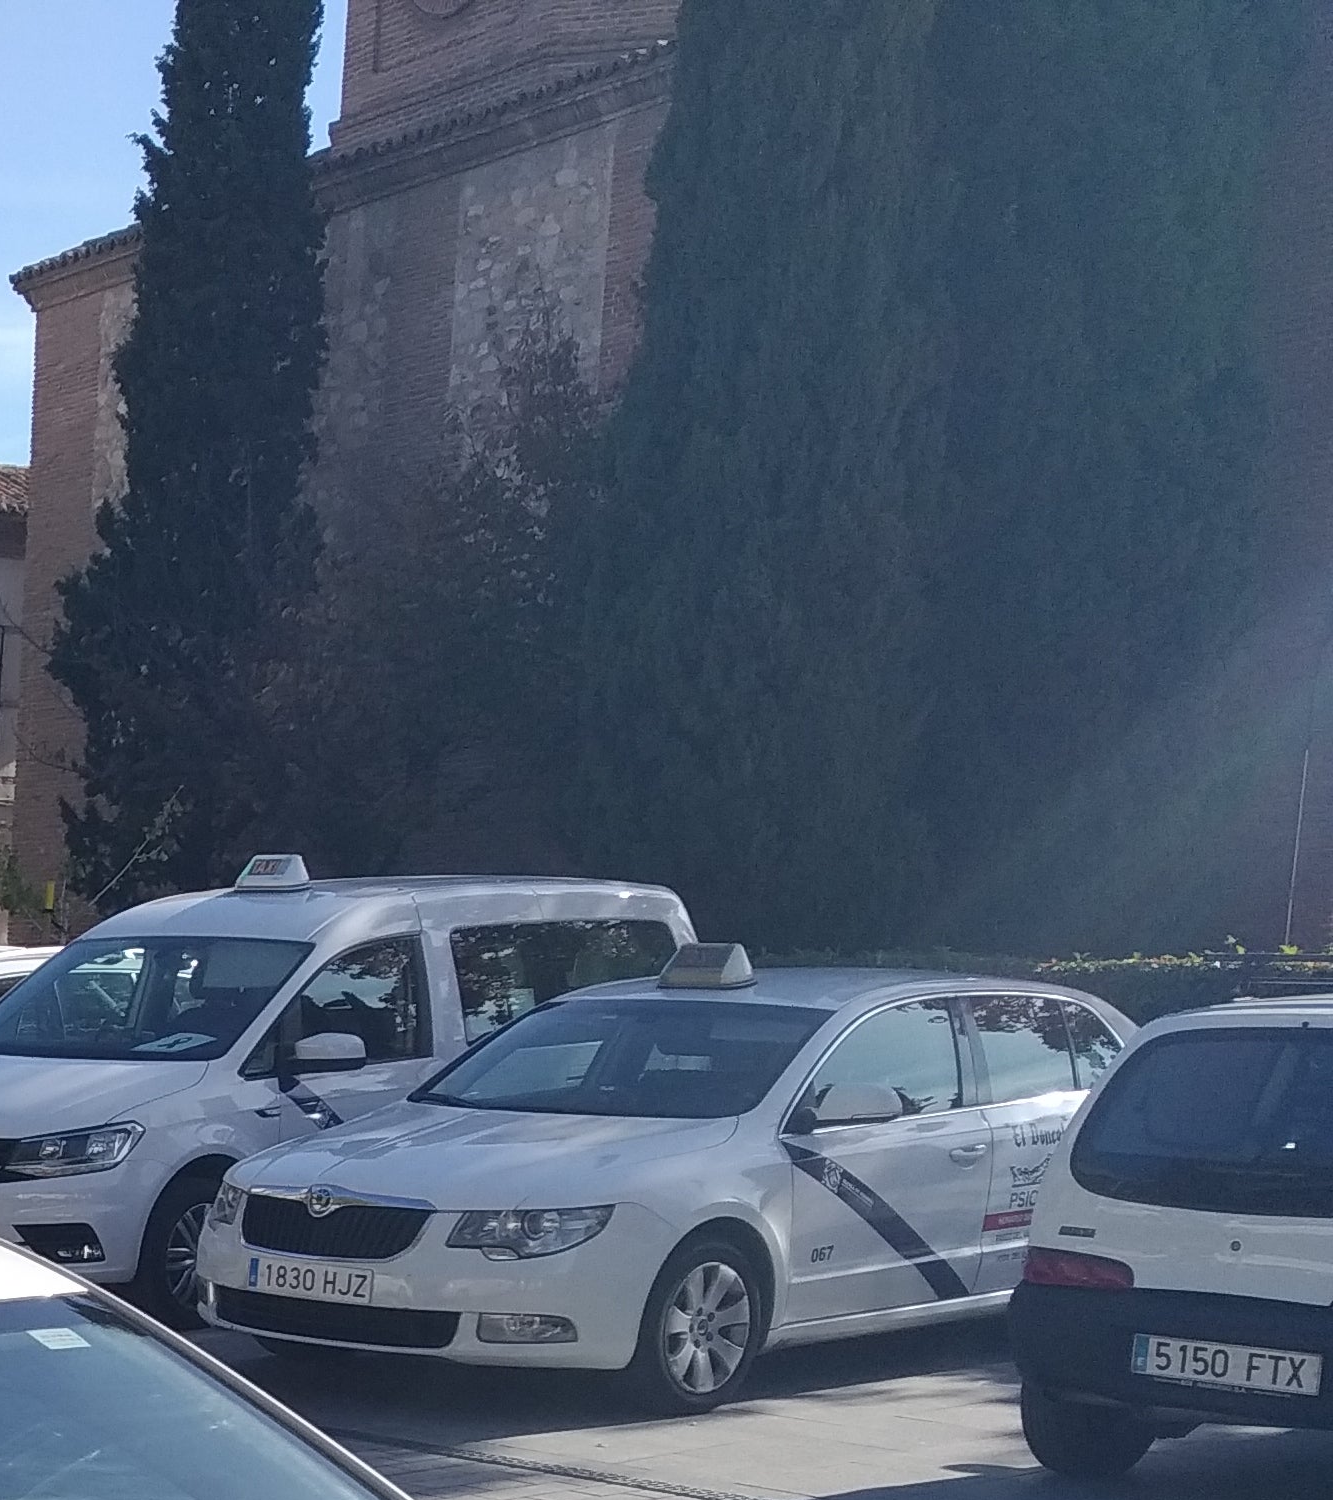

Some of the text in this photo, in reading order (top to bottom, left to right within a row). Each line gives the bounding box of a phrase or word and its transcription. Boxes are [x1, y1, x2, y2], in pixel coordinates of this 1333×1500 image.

[252, 861, 280, 874] TAXI
[811, 1244, 834, 1263] 067
[266, 1263, 368, 1298] 1830 HJZ
[1155, 1341, 1229, 1378] 5150
[1245, 1352, 1306, 1388] FTX
